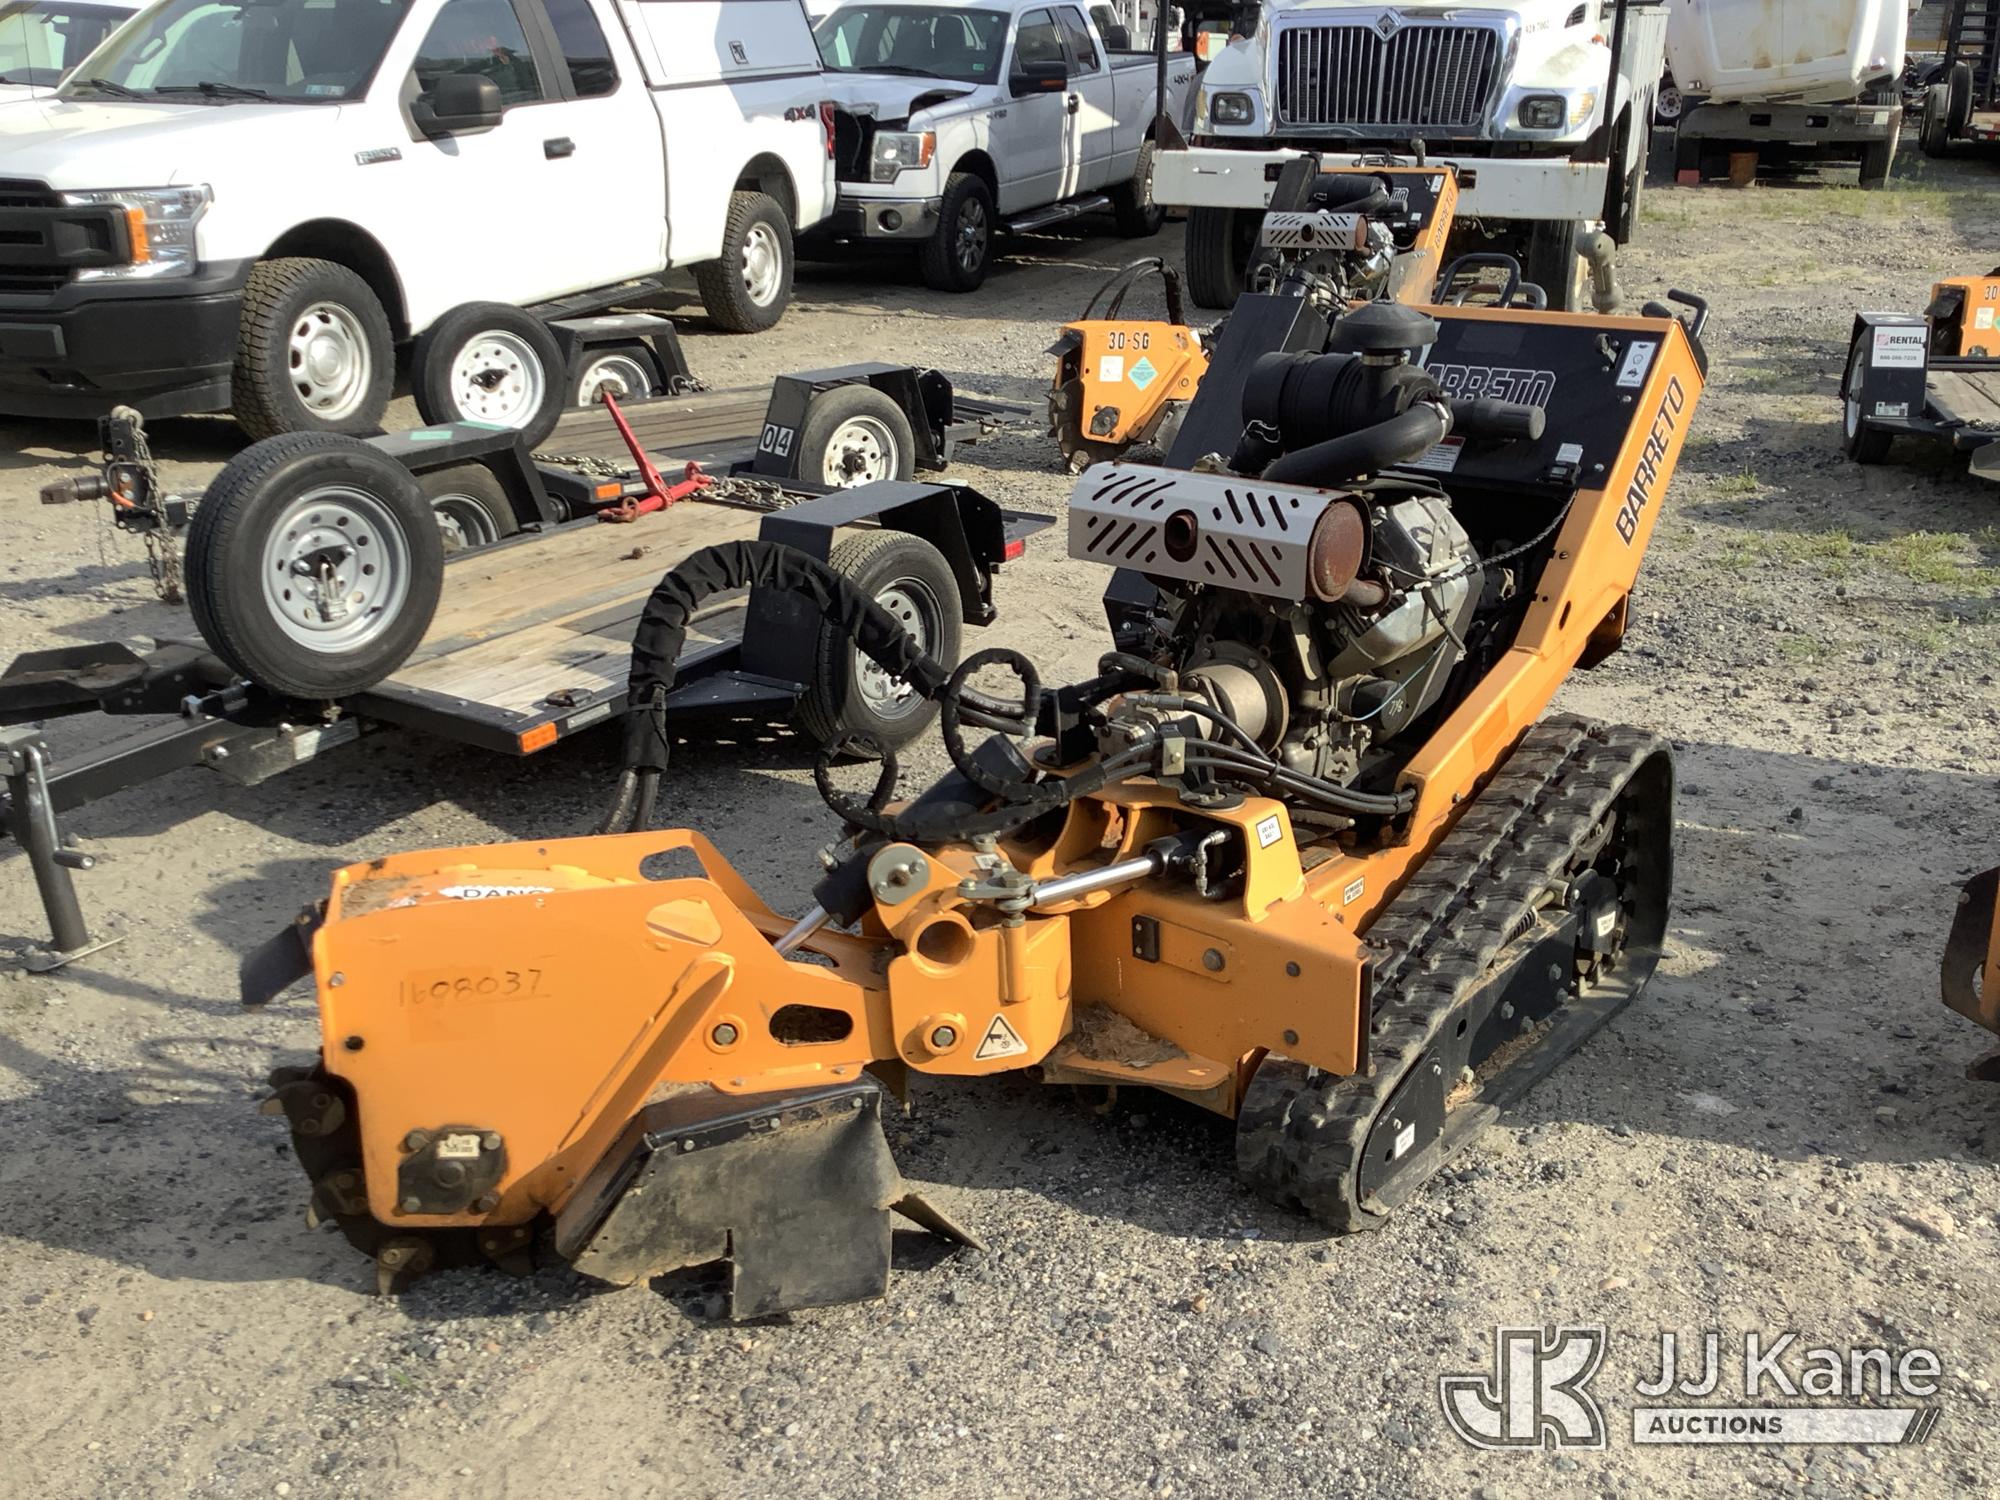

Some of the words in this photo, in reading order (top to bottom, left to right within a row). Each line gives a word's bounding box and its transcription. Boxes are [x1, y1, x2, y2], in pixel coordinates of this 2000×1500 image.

[1108, 331, 1150, 350] 30-SG
[1889, 336, 1923, 345] RENTAL
[1615, 375, 1685, 547] BARRETO
[399, 968, 542, 1008] 1608037
